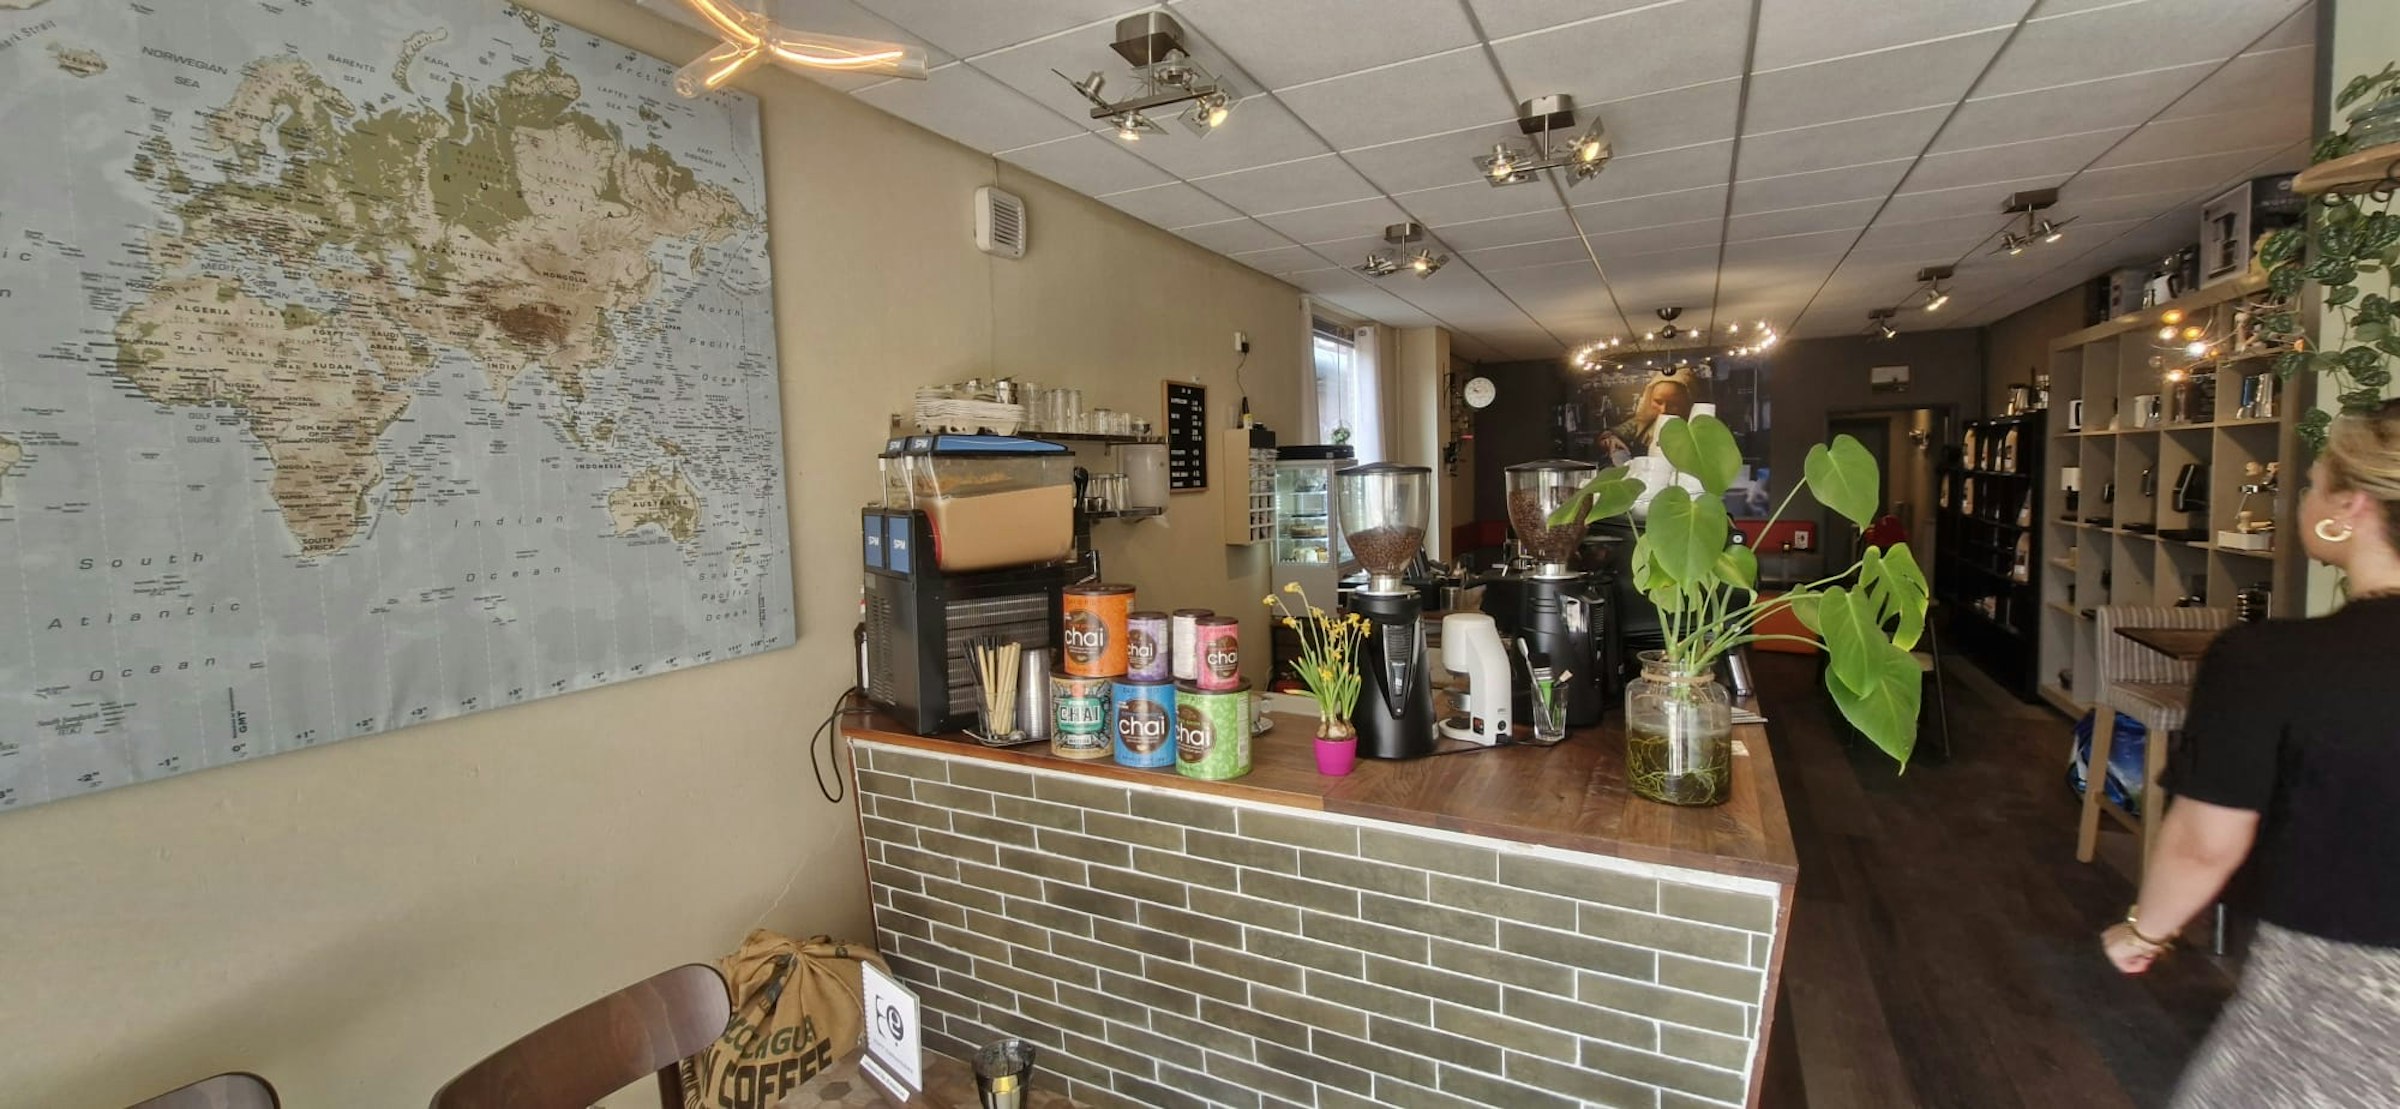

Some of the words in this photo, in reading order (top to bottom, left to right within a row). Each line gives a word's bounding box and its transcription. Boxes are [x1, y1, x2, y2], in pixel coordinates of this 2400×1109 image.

[141, 46, 228, 75] NORWEGIAN
[327, 53, 376, 73] BARENTS
[174, 75, 201, 89] SEA
[343, 74, 364, 86] SEA
[615, 63, 668, 87] Arctic
[543, 271, 588, 283] MONGOLIA
[125, 281, 175, 293] MOROCCO
[175, 304, 231, 316] ALGERIA
[698, 303, 741, 317] North
[312, 361, 353, 371] SUDAN
[487, 362, 517, 371] INDIA
[188, 411, 211, 419] GULF
[187, 436, 221, 444] GUINEA
[633, 499, 688, 508] AUSTRALIA
[454, 514, 564, 529] Indian
[302, 544, 336, 552] AFRICA
[79, 552, 204, 571] South
[466, 566, 562, 582] Ocean
[47, 601, 240, 630] Atlantic
[1064, 625, 1104, 647] chai
[1207, 649, 1238, 665] cha
[89, 656, 216, 682] Ocean
[238, 710, 248, 733] GMT
[1060, 706, 1100, 722] CHAI
[1118, 715, 1165, 736] chai
